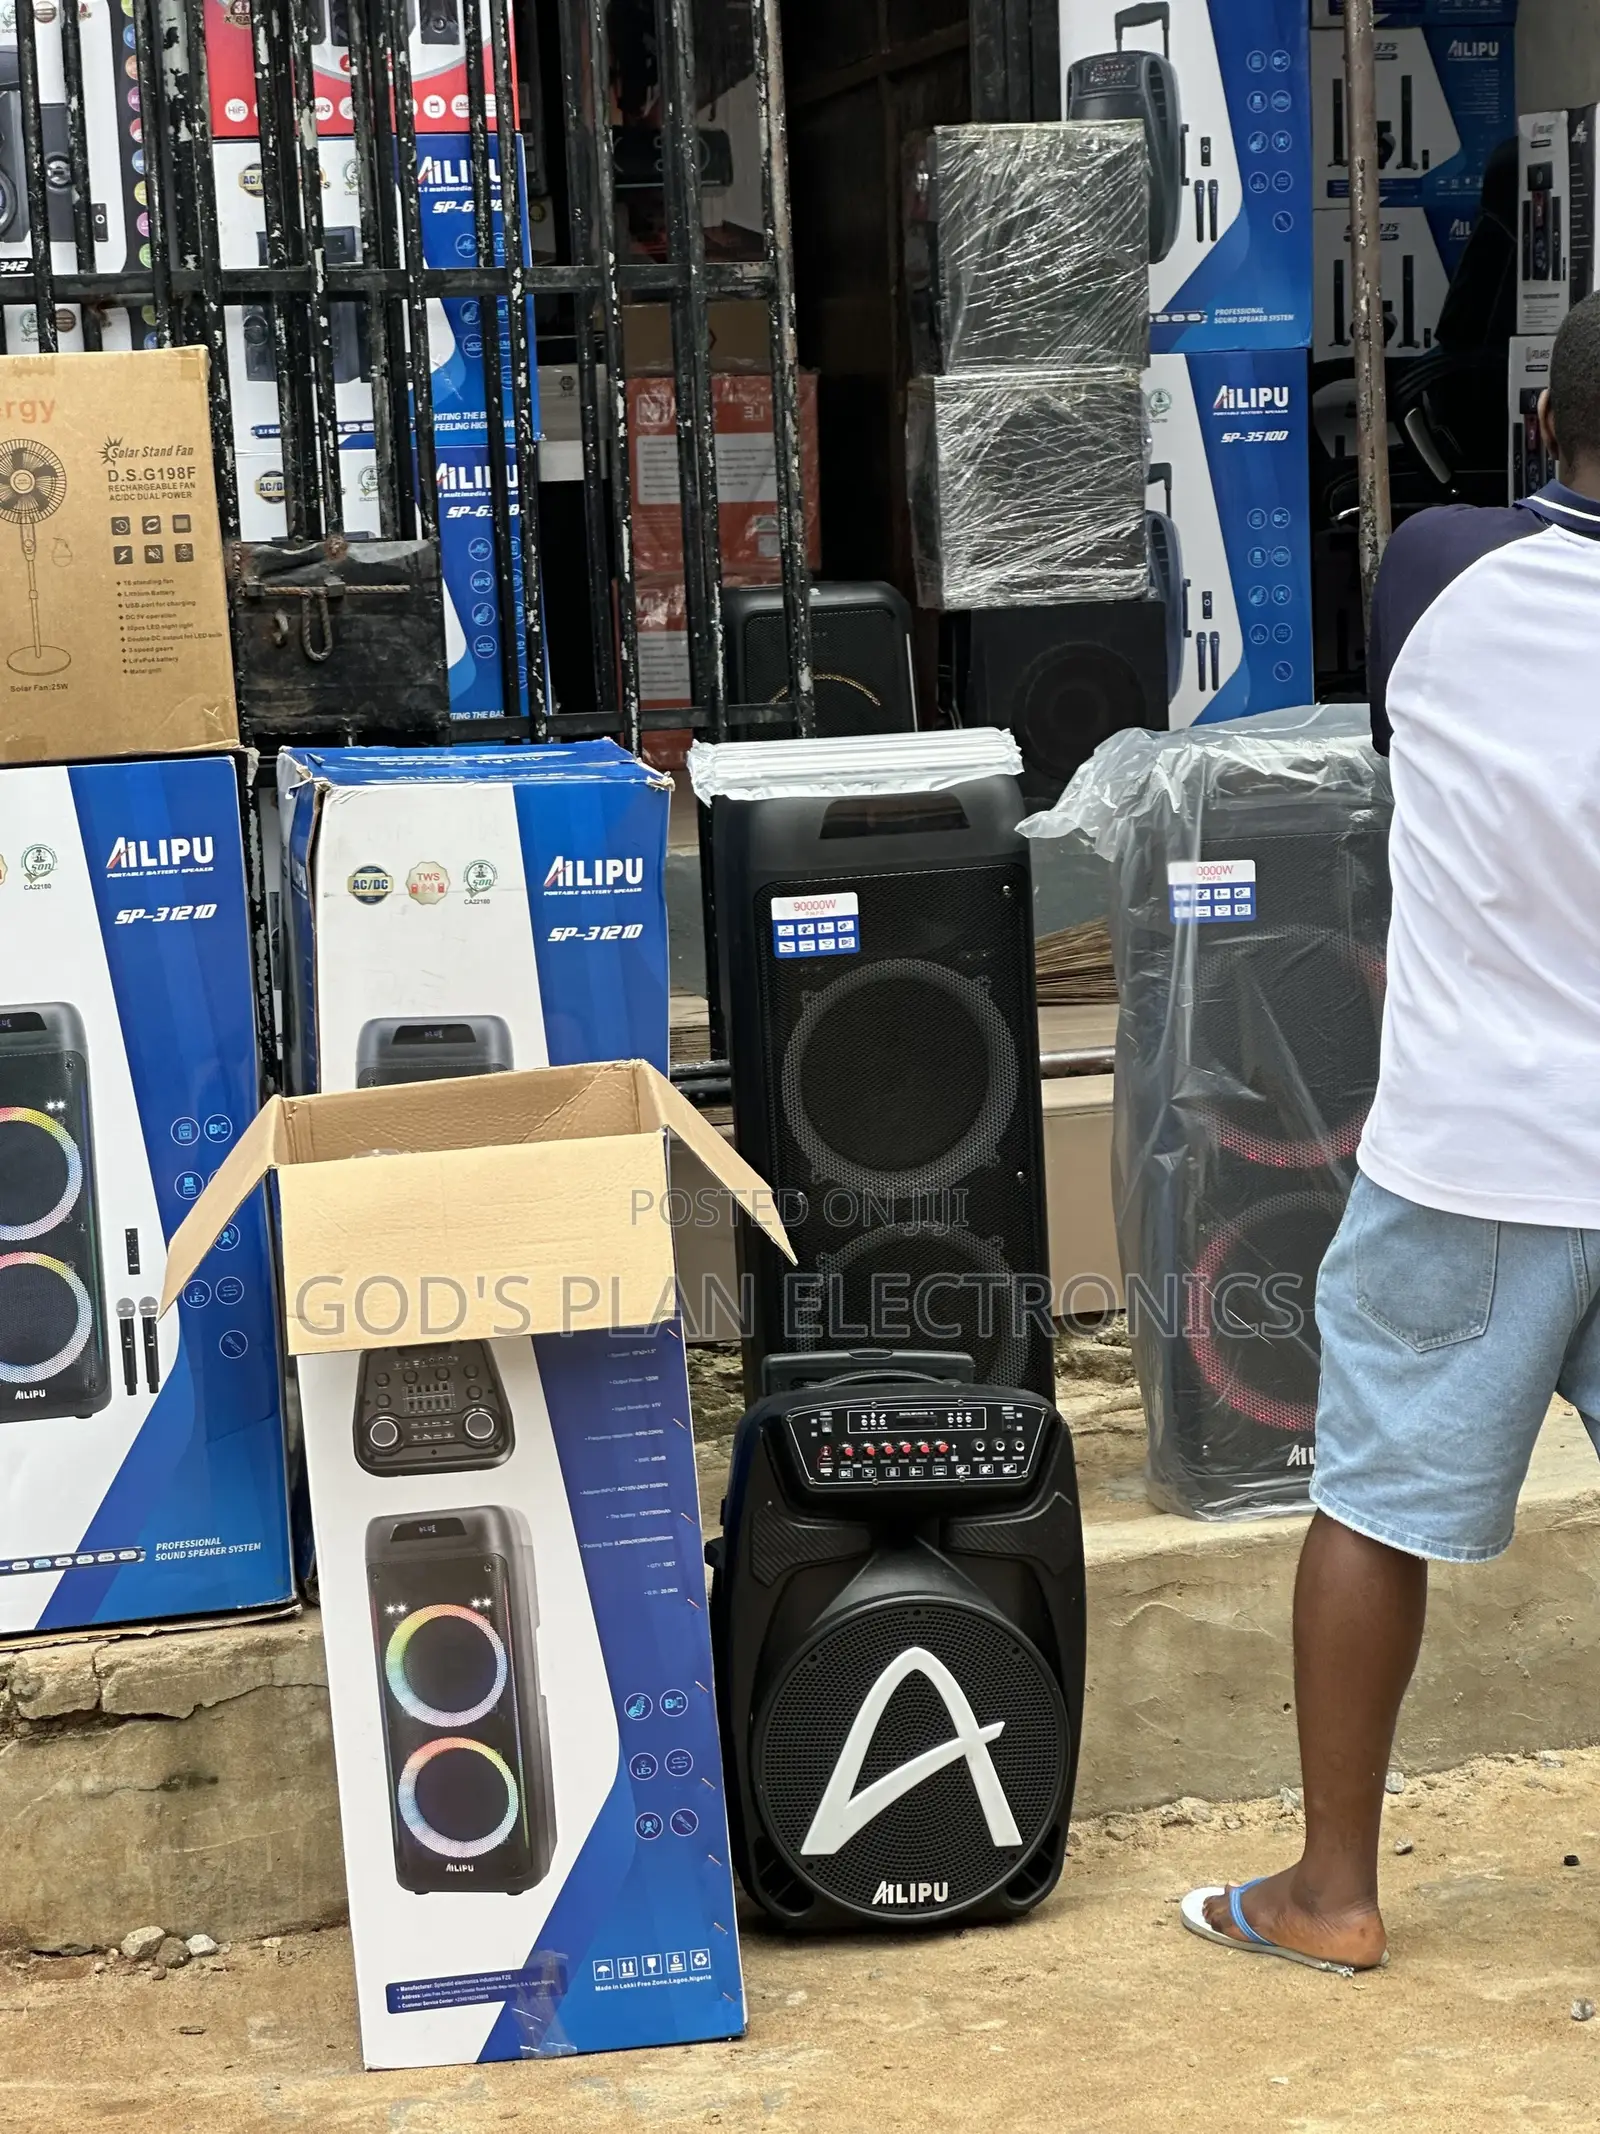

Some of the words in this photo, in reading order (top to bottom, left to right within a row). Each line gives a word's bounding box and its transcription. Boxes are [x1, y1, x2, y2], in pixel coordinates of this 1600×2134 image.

[1448, 39, 1499, 56] AILIPU
[418, 156, 501, 184] AILIU
[1238, 315, 1268, 323] SPEAKER
[1213, 385, 1289, 409] AILIPU
[0, 398, 56, 423] rgy
[462, 411, 479, 420] THE
[434, 422, 469, 431] FEELING
[470, 421, 488, 430] HIG
[1221, 431, 1289, 442] SP-3510D
[111, 447, 140, 458] Solar
[142, 445, 174, 457] Stand
[176, 444, 194, 456] Fan
[108, 466, 196, 482] D.S.G198F
[108, 482, 177, 492] RECHARGEABLE
[180, 481, 196, 489] FAN
[259, 481, 285, 491] AC/D
[109, 493, 136, 501] AC/DC
[137, 492, 160, 500] DUAL
[161, 491, 193, 499] POWER
[10, 684, 32, 692] Solar
[450, 712, 471, 720] TING
[472, 711, 488, 719] THE
[106, 836, 215, 869] AILIPU
[107, 870, 144, 878] PORTABLE
[181, 866, 214, 874] SPEAKER
[416, 872, 441, 882] TWS
[543, 855, 644, 888] AILIPU
[353, 878, 389, 890] AC/DC
[114, 903, 218, 925] SP-3121D
[547, 924, 644, 942] SP-3121D
[189, 1293, 206, 1304] LED
[15, 1388, 47, 1400] AILIPU
[1287, 1444, 1316, 1466] AIL
[156, 1537, 222, 1551] PROFESSIONAL
[155, 1550, 187, 1561] SOUND
[187, 1546, 226, 1559] SPEAKER
[228, 1542, 261, 1553] SYSTEM
[636, 1766, 652, 1775] LED
[445, 1863, 475, 1873] AILIPU
[871, 1881, 949, 1905] AILIPU
[434, 1981, 454, 1989] Splendid
[454, 1979, 479, 1987] electronics
[620, 1981, 637, 1989] Lekki
[637, 1980, 651, 1988] Free
